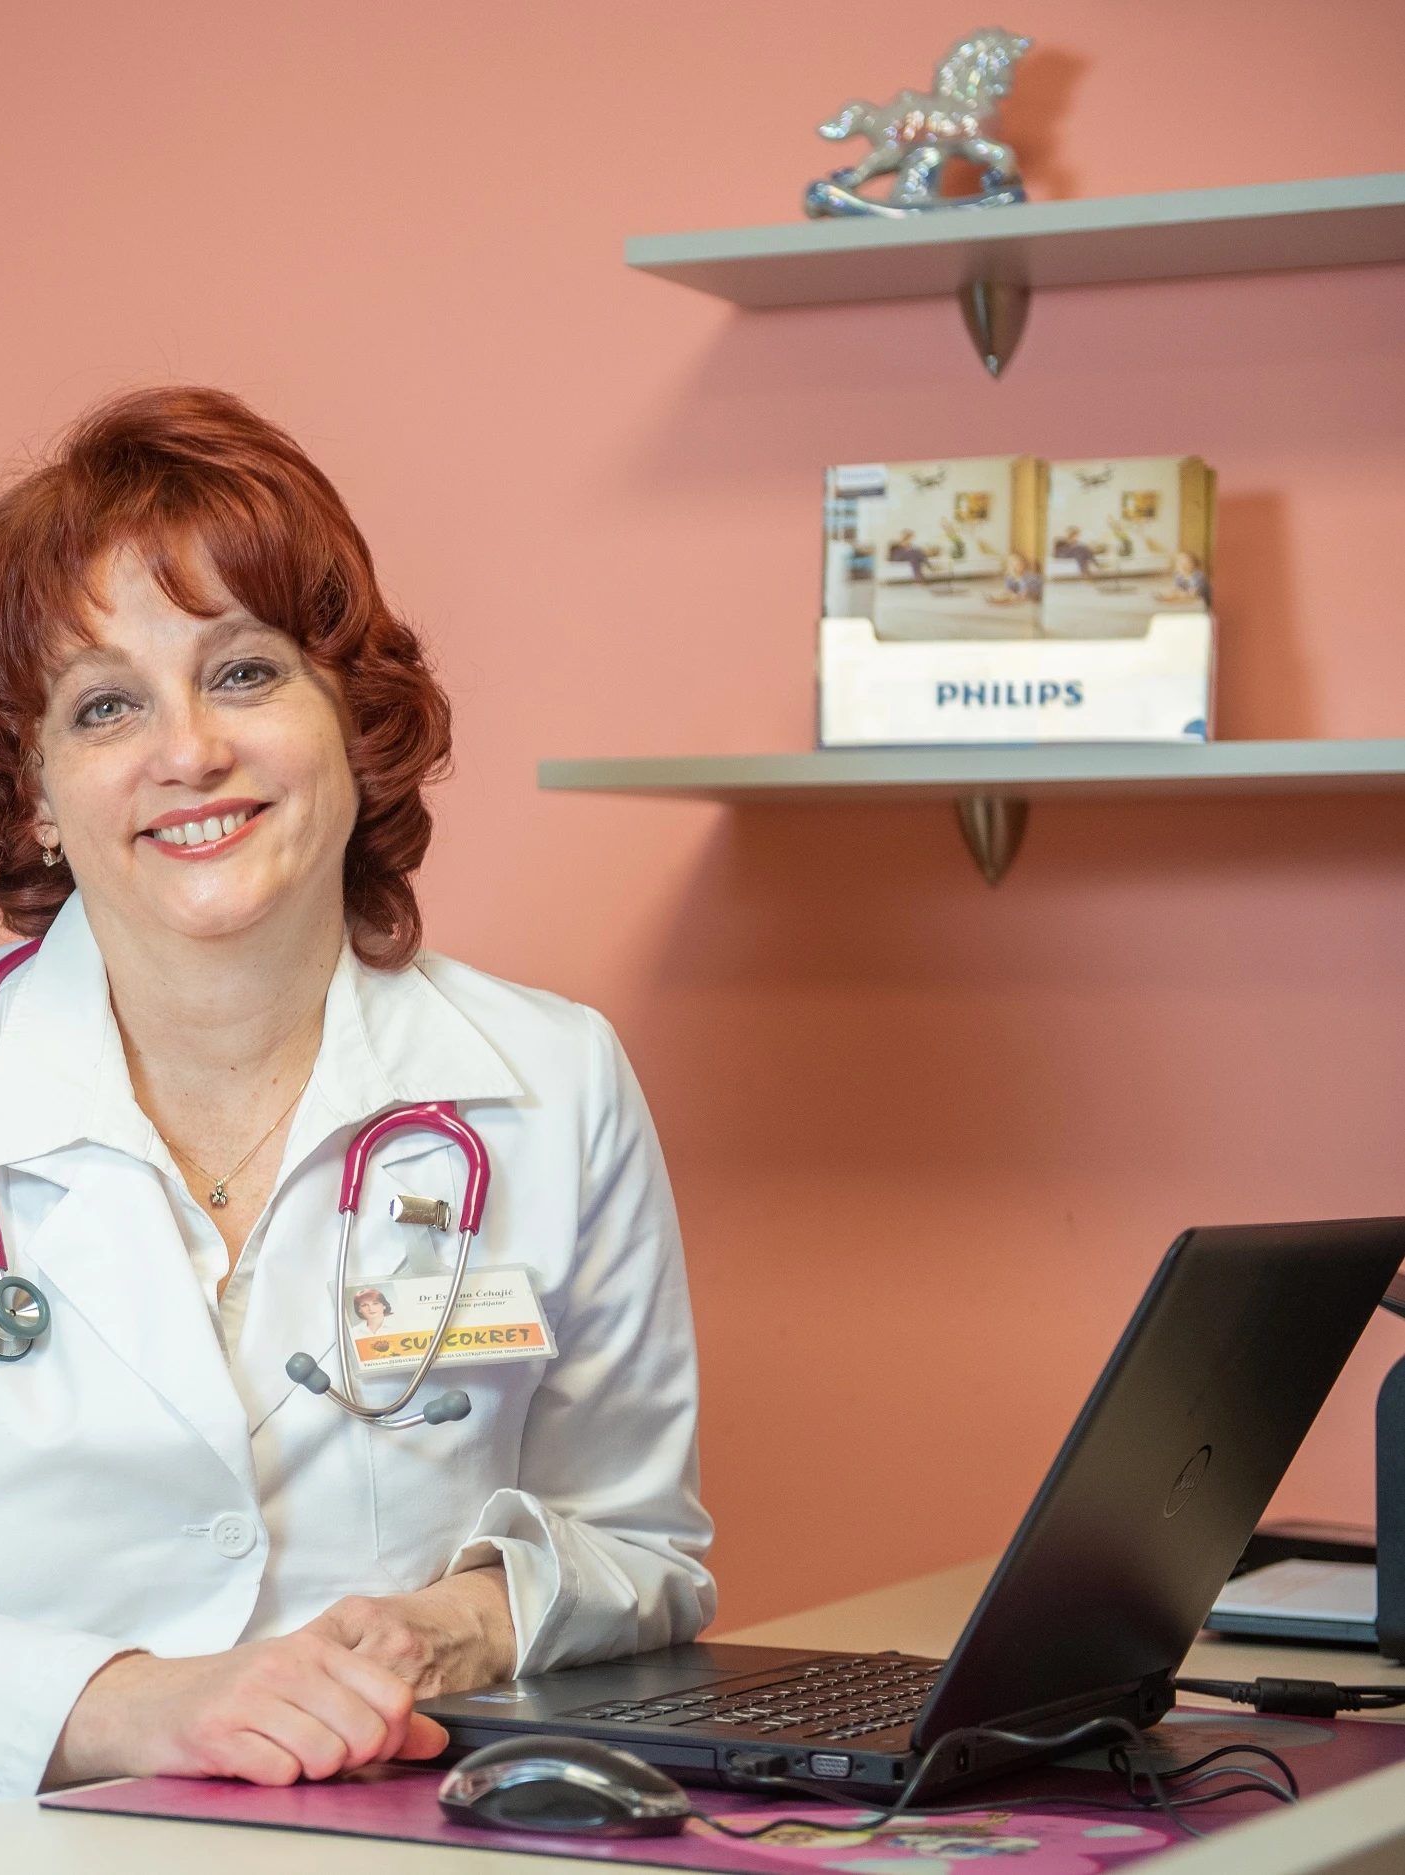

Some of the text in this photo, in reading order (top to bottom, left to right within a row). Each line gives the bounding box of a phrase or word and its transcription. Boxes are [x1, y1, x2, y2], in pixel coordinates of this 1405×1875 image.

[935, 680, 1084, 708] PHILIPS
[419, 1294, 432, 1302] Dr
[475, 1288, 514, 1298] Čehajić
